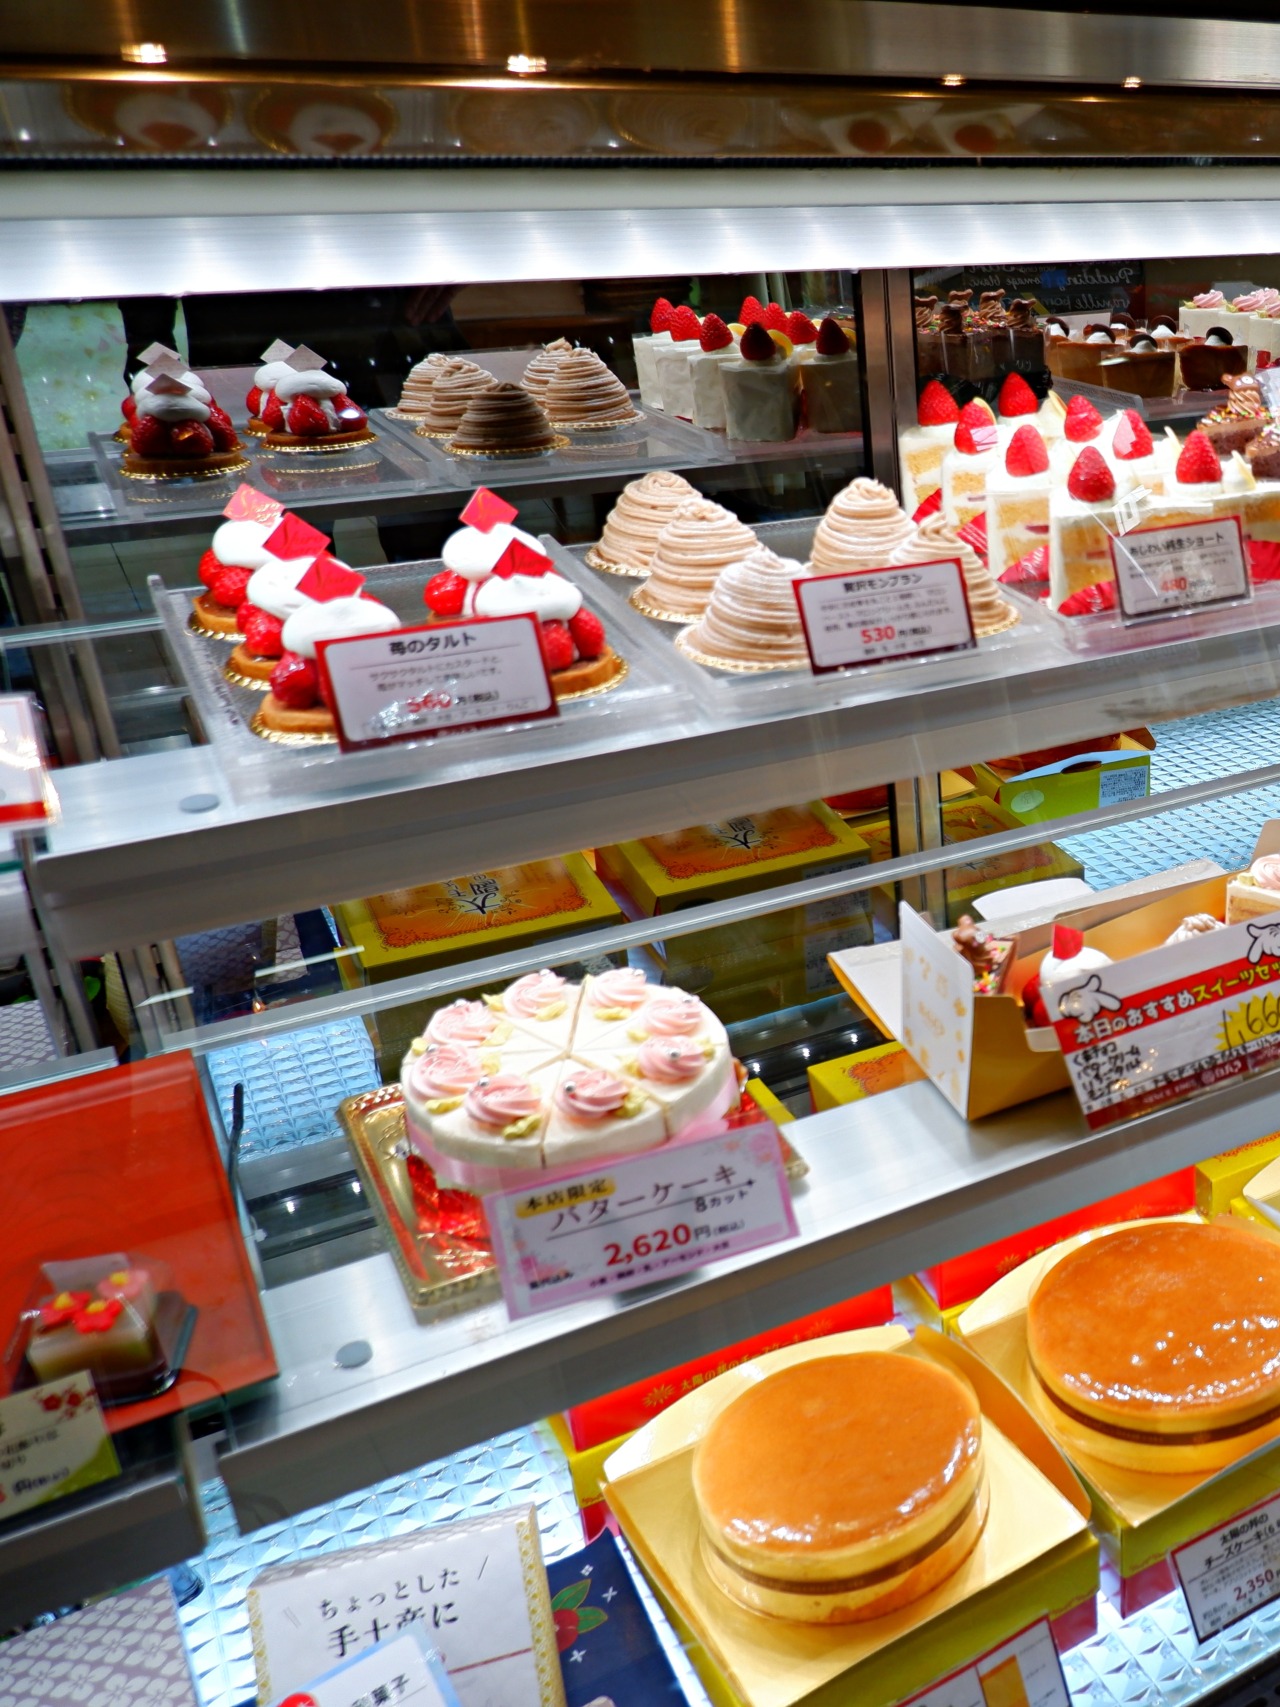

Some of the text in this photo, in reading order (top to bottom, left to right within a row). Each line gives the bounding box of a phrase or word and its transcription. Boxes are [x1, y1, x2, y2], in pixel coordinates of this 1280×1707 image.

[388, 632, 477, 655] 苺のタルト
[860, 625, 896, 644] 530
[527, 1180, 609, 1211] 本店限定
[551, 1164, 737, 1231] バターケーキ
[694, 1189, 749, 1213] 8カット
[603, 1223, 692, 1267] 2,620
[318, 1567, 460, 1620] ちょっとした
[1233, 1568, 1275, 1602] 2,350
